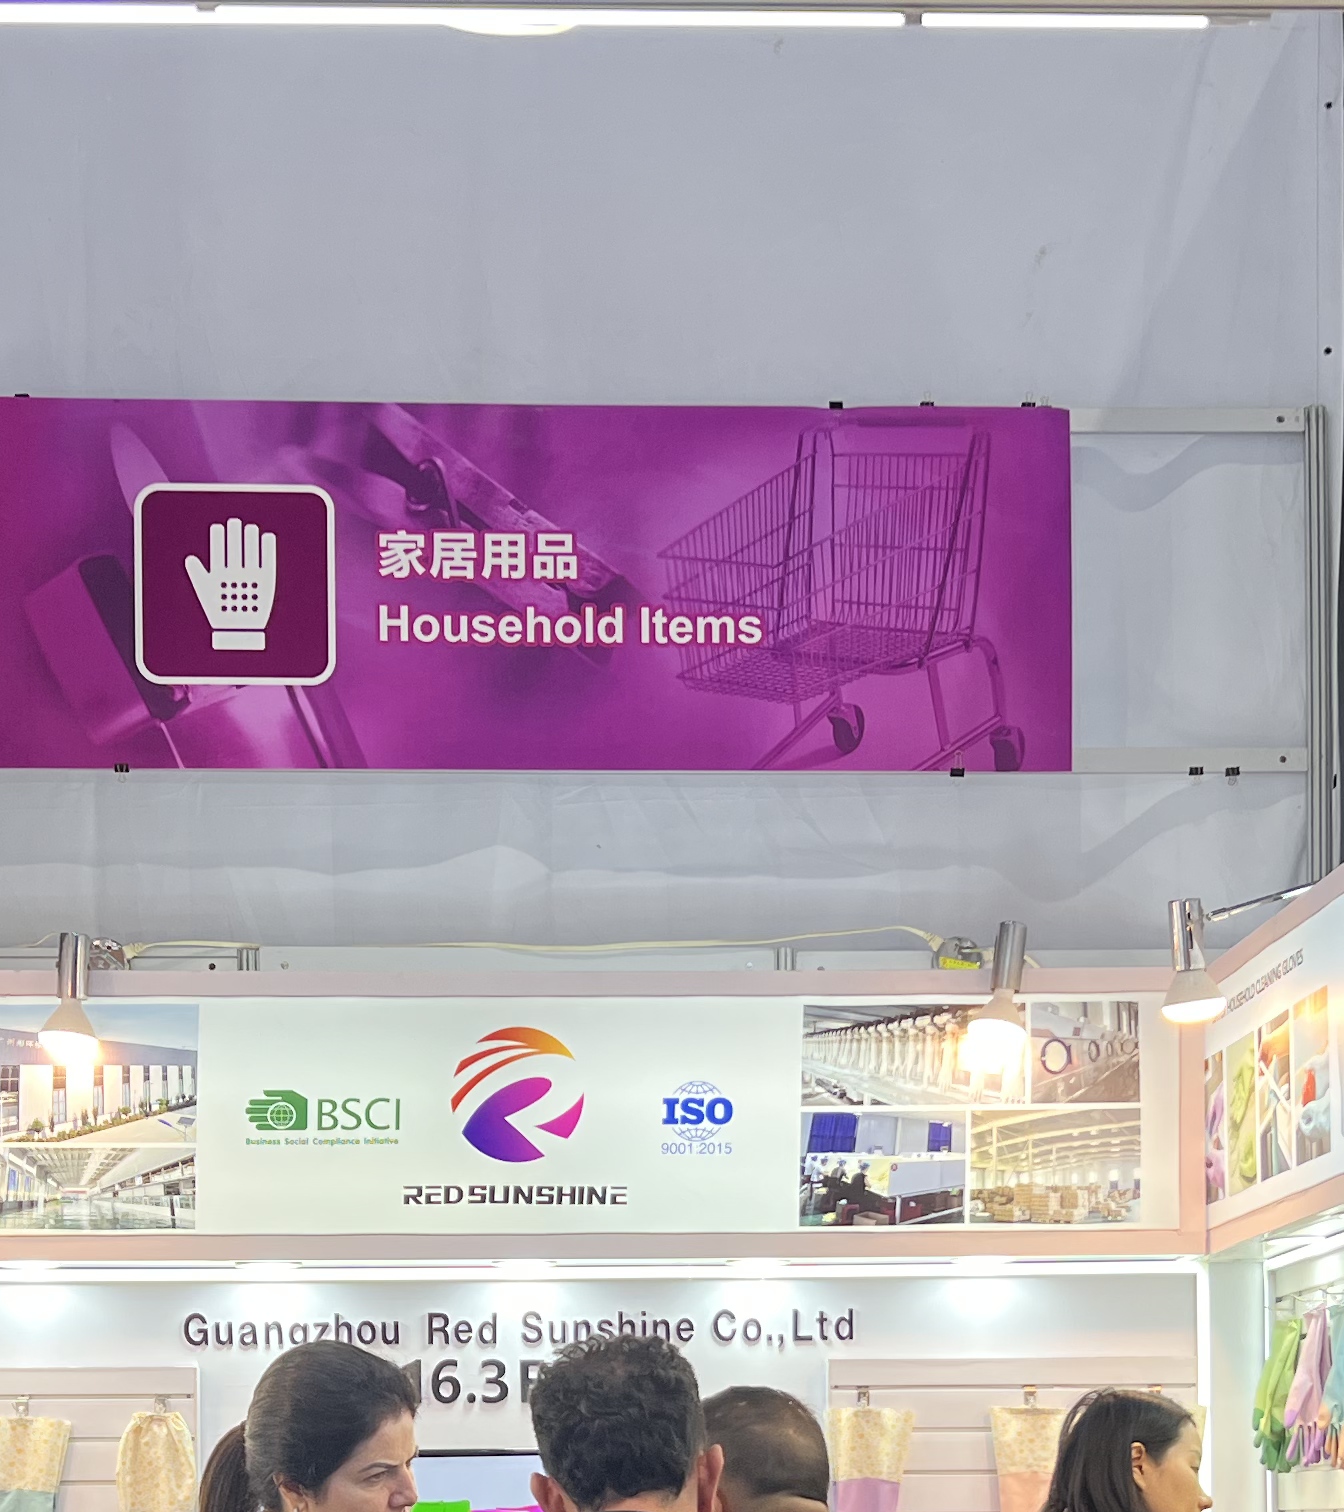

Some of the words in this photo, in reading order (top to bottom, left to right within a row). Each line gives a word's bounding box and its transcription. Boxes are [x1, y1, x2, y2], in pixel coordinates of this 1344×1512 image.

[377, 530, 579, 581] 家居用品
[378, 604, 624, 644] Household
[640, 605, 763, 644] Items
[317, 1097, 401, 1131] BSCI
[662, 1097, 734, 1125] ISO
[245, 1137, 281, 1146] Business
[284, 1137, 309, 1146] Social
[312, 1137, 361, 1147] Compliance
[363, 1136, 399, 1146] Initiative
[660, 1142, 733, 1155] 9001:2015
[182, 1312, 400, 1347] Guangzhou
[426, 1311, 498, 1345] Red
[520, 1309, 695, 1345] Sunshine
[711, 1307, 855, 1354] Co.,Ltd
